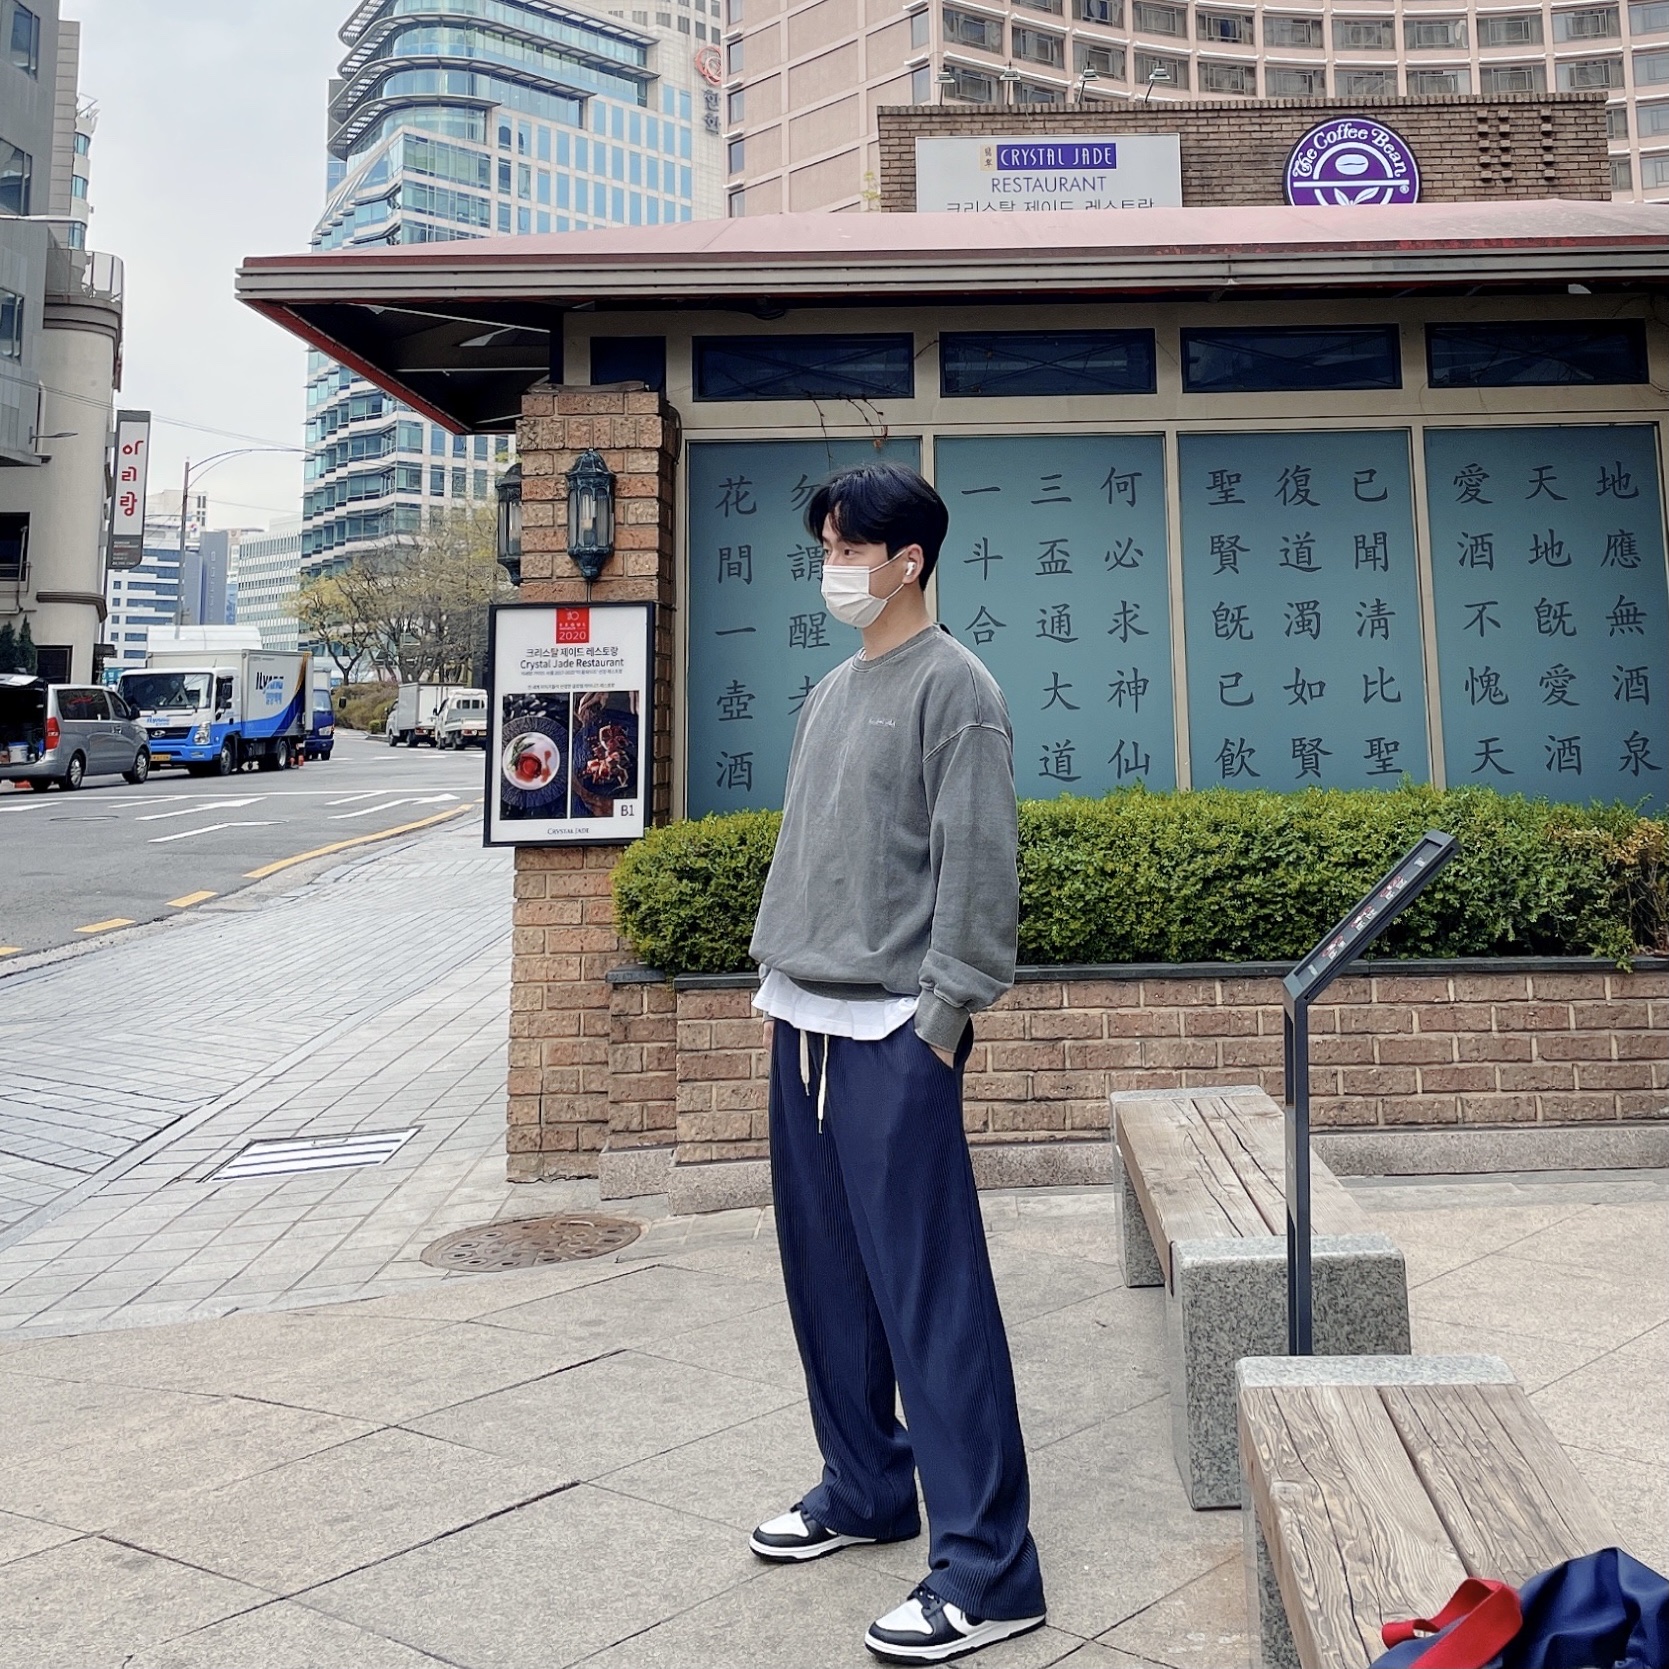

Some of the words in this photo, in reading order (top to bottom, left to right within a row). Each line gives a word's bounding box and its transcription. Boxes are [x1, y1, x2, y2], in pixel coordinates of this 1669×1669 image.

[1000, 148, 1065, 167] CRYSTAL
[1072, 146, 1113, 166] JADE
[1292, 148, 1317, 178] The
[1313, 122, 1369, 150] Coffee
[1371, 128, 1408, 178] Bean
[991, 176, 1107, 193] RESTAURANT
[119, 440, 145, 517] 아리랑
[1100, 466, 1151, 786] 何必求神仙
[1453, 462, 1515, 776] 愛酒不愧天
[559, 631, 587, 641] 2020
[526, 647, 559, 658] 크리스탈
[560, 647, 585, 657] 제이드
[586, 646, 619, 657] 레스토랑
[520, 659, 551, 671] Crystal
[553, 659, 575, 668] Jade
[576, 658, 625, 668] Restaurant
[620, 804, 635, 817] B1
